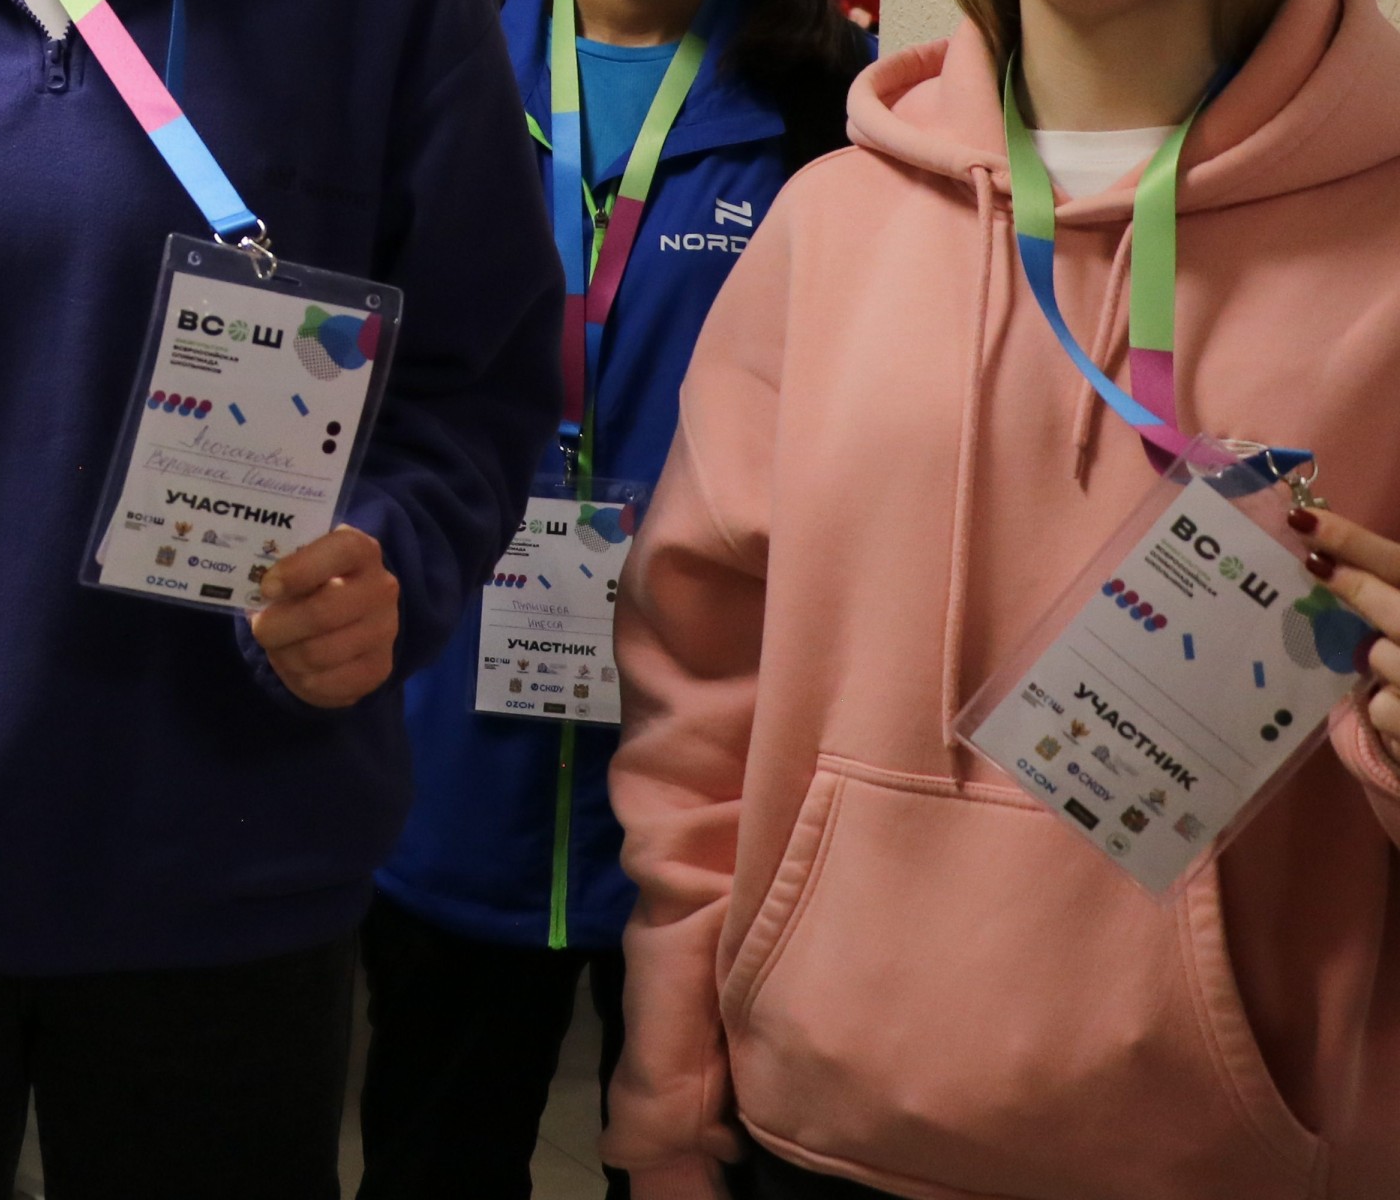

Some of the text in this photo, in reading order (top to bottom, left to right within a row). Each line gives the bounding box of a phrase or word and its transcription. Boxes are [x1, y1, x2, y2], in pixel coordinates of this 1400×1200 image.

[660, 233, 749, 254] NORD
[165, 489, 295, 530] УЧАСТНИК
[516, 519, 567, 536] СОШ
[146, 575, 189, 591] OZON
[507, 638, 597, 657] УЧАСТНИК
[505, 700, 535, 710] OZON
[1074, 682, 1199, 792] УЧАСТНИК
[1016, 758, 1058, 795] OZON
